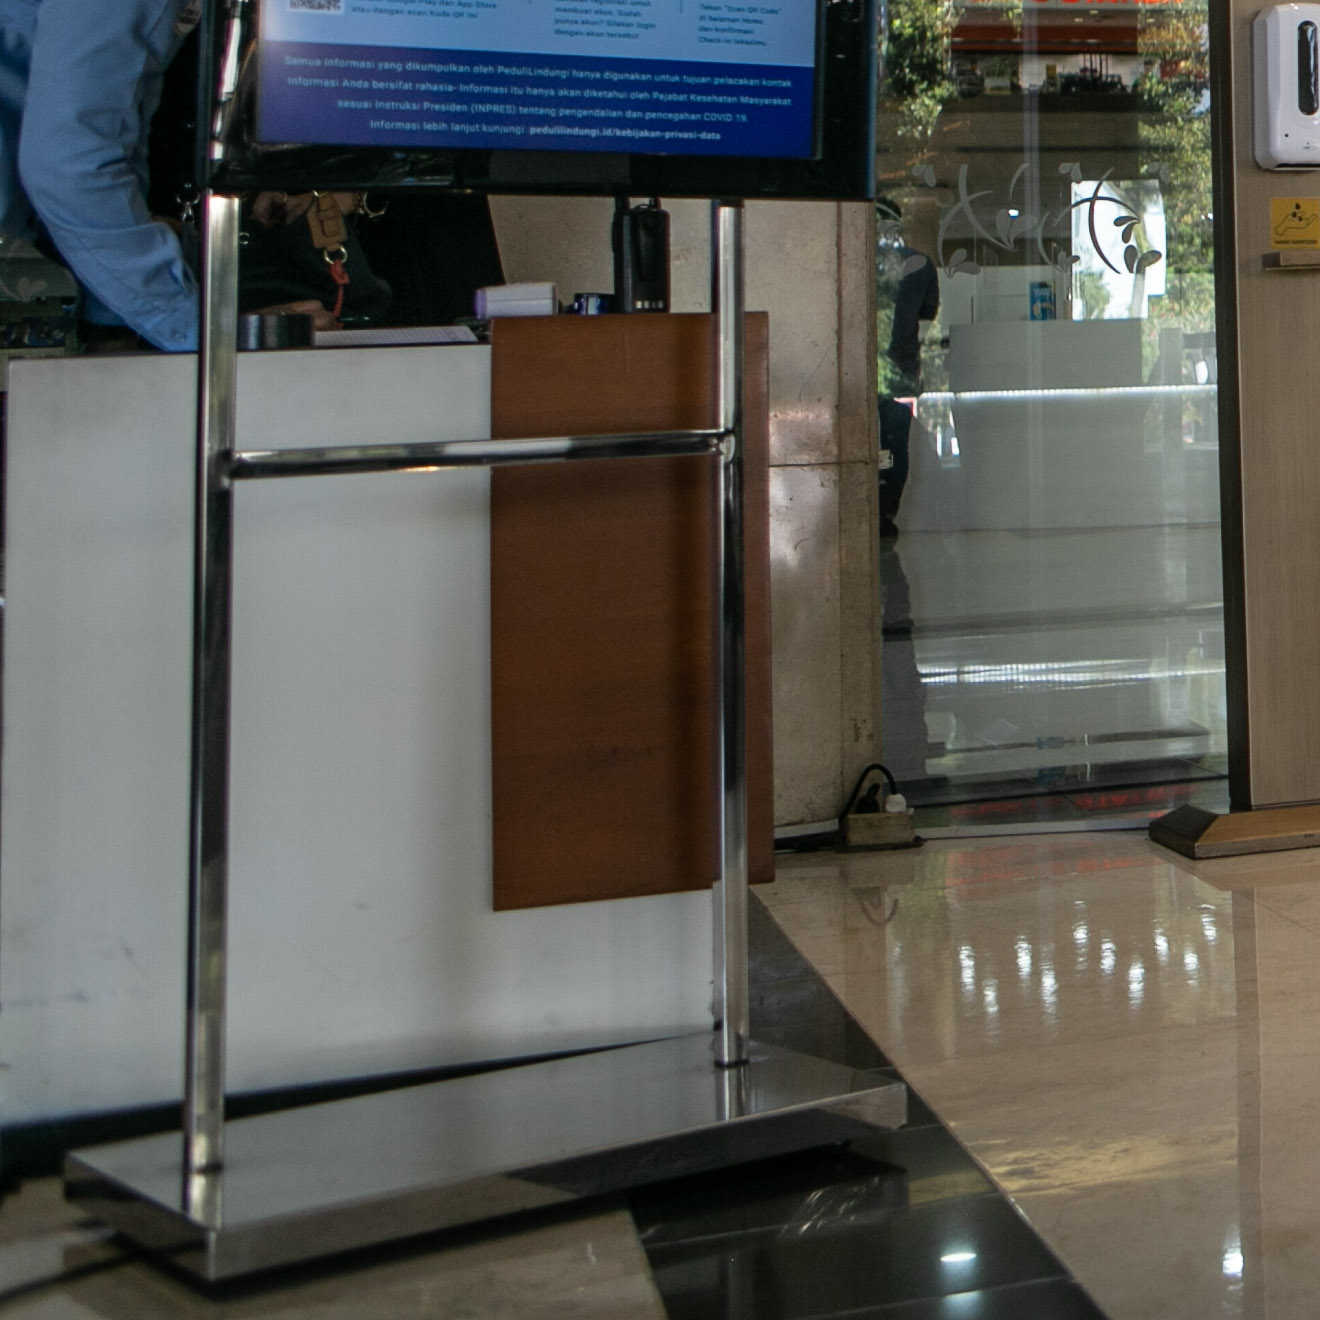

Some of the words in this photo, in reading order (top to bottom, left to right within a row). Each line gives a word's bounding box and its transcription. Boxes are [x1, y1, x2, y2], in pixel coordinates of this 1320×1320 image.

[377, 60, 403, 73] yang
[405, 60, 471, 74] dikumpulkan
[473, 64, 494, 75] oleh
[497, 65, 570, 79] PeduliLindungi
[572, 69, 601, 81] hanya
[603, 71, 652, 83] digunakan
[654, 74, 680, 84] untuk
[713, 76, 760, 88] pelacakan
[288, 76, 339, 88] Informasi
[342, 78, 369, 90] Anda
[372, 79, 412, 92] bersifat
[460, 83, 508, 95] Informasi
[510, 85, 523, 96] itu
[526, 86, 555, 99] hanya
[558, 88, 581, 98] akan
[583, 88, 627, 100] diketahui
[630, 90, 650, 101] oleh
[652, 91, 688, 104] Pejabat
[690, 94, 738, 105] Kesehatan
[740, 96, 792, 108] Masyarakat
[337, 98, 372, 110] sesuai
[375, 99, 420, 112] Instruksi
[423, 101, 468, 114] Presiden
[470, 102, 516, 116] (INPRES)
[519, 105, 556, 119] tentang
[559, 108, 623, 121] pengendalian
[625, 109, 643, 120] dan
[645, 111, 702, 124] pencegahan
[703, 112, 733, 123] COVID
[370, 119, 420, 132] Informasi
[423, 122, 448, 133] lebih
[451, 123, 480, 135] lanjut
[482, 124, 525, 137] kunjungi
